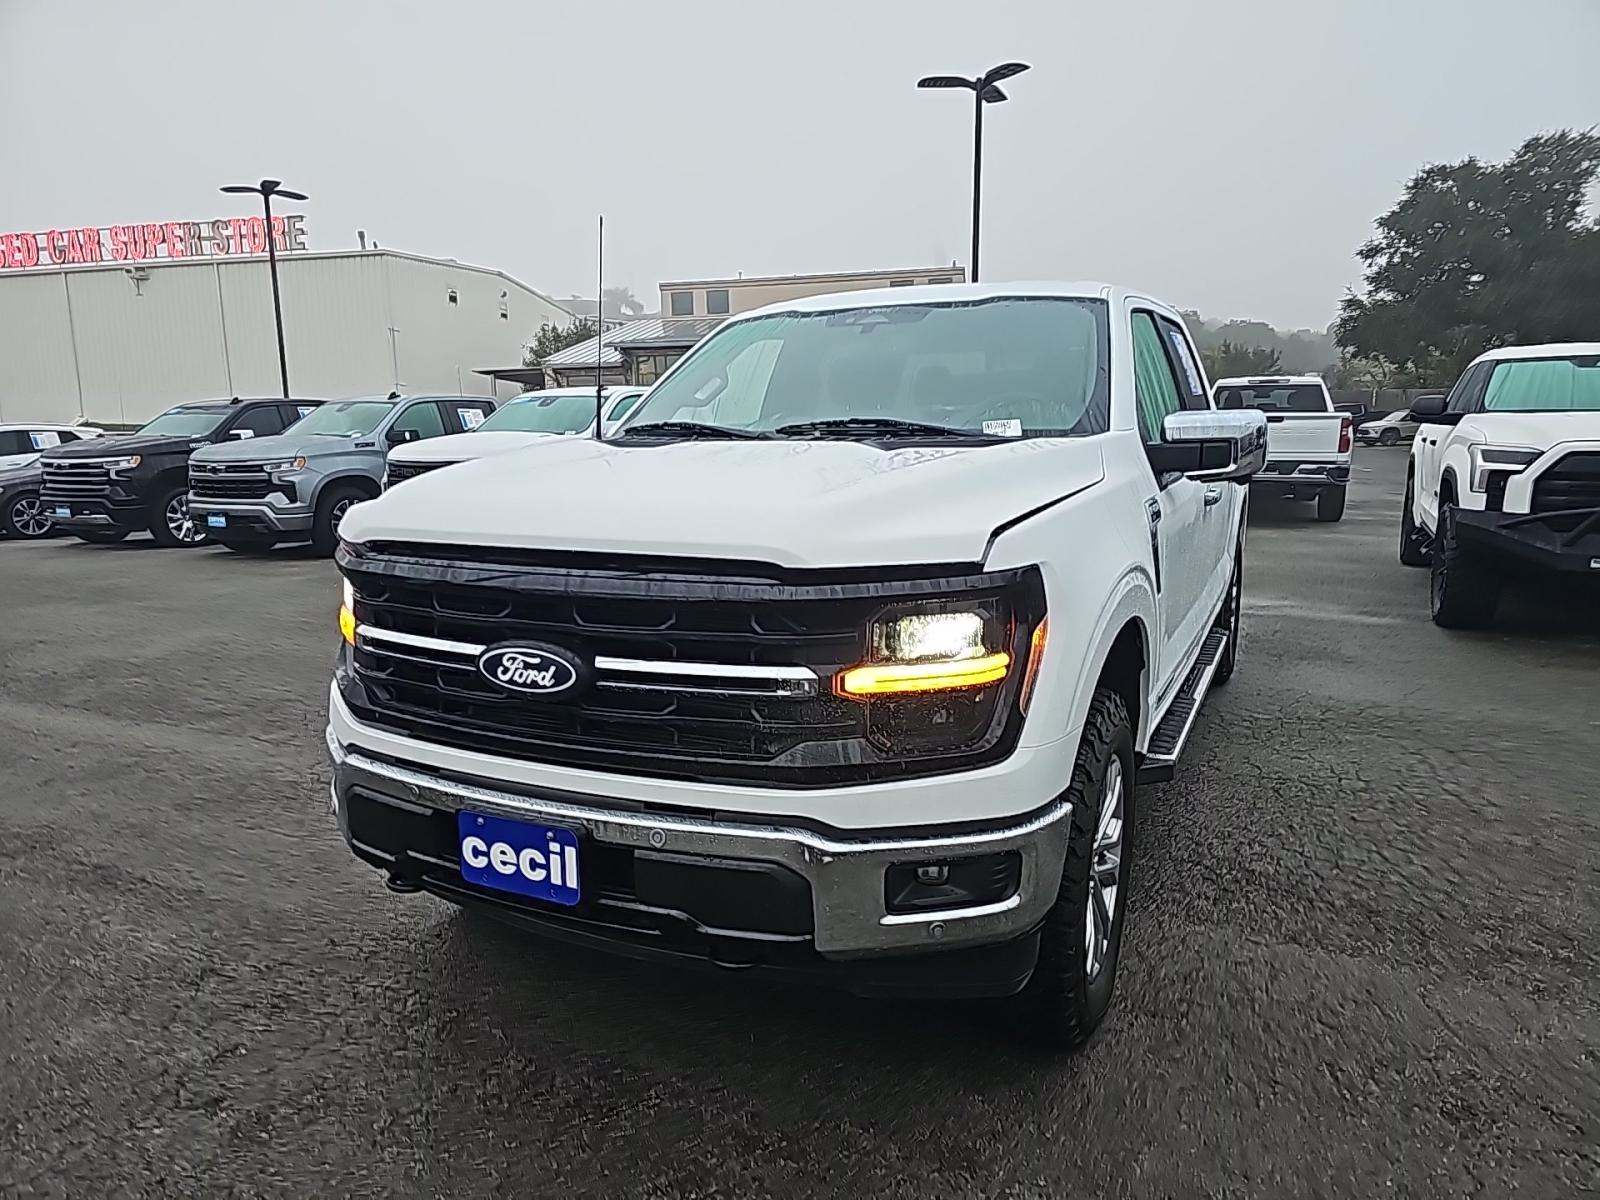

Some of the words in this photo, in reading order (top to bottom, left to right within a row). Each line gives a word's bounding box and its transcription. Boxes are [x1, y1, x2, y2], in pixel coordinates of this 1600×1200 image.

[47, 227, 103, 264] CAR
[110, 222, 203, 260] SUPER
[212, 215, 308, 256] STORE
[497, 652, 557, 687] Ford
[462, 836, 578, 890] cecil
